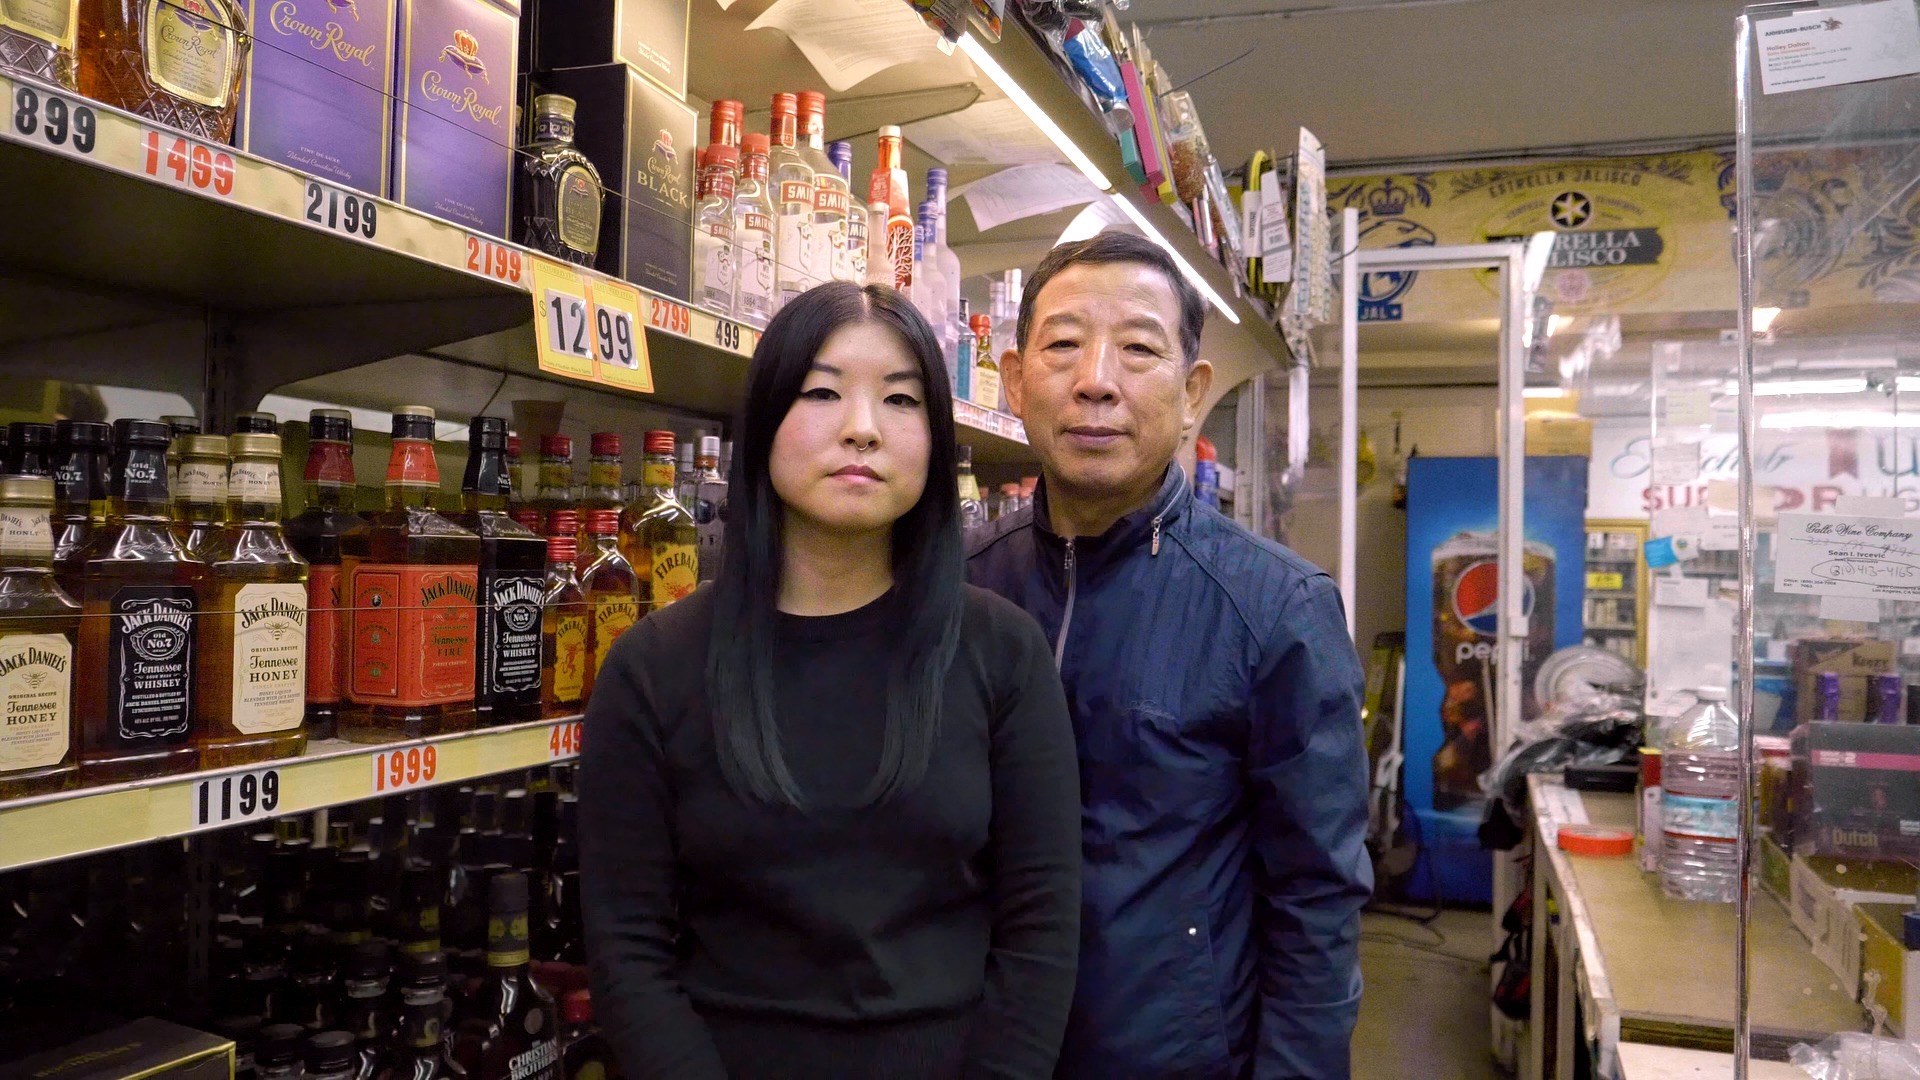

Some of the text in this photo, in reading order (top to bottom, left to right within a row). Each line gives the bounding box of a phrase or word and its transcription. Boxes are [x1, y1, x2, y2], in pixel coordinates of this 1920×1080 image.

[270, 0, 376, 67] Crown Royal
[1764, 24, 1822, 37] ANHEUSER-BUSCH
[161, 24, 217, 59] Crown Royal
[421, 70, 503, 126] Crown Royal
[15, 87, 96, 153] 899
[146, 130, 234, 196] 1499
[647, 156, 665, 175] Crown
[637, 170, 690, 208] BLACK
[1489, 169, 1642, 198] ESTRELLA JALISCO
[307, 183, 377, 239] 2199
[467, 236, 521, 283] 2199
[539, 299, 547, 318] $
[651, 298, 690, 335] 2799
[1360, 306, 1388, 321] JAL
[715, 320, 740, 350] 499
[54, 471, 84, 481] No.7
[124, 467, 157, 480] No.7
[132, 462, 149, 470] Old
[1805, 522, 1914, 542] Gallo Wine Company
[1828, 549, 1848, 557] Sean
[1857, 551, 1886, 559] Ivcevic
[421, 582, 445, 607] JACK
[493, 580, 545, 611] JACK DANIEL'S
[120, 602, 193, 634] JACK DANIEL'S
[240, 597, 305, 629] JACK DANIEL'S
[513, 613, 529, 622] No.7
[146, 638, 172, 649] No.7
[502, 632, 537, 644] Tennessee
[0, 646, 67, 677] JACK DANIEL'S
[249, 655, 298, 670] Tennessee
[502, 647, 536, 658] WHISKEY
[133, 661, 182, 675] Tennessee
[249, 669, 299, 683] HONEY
[133, 678, 181, 690] WHISKEY
[7, 700, 57, 714] Tennessee
[6, 712, 58, 726] HONEY
[550, 721, 585, 757] 449
[376, 745, 437, 792] 1999
[198, 770, 280, 826] 1199
[1832, 826, 1879, 847] Dutch
